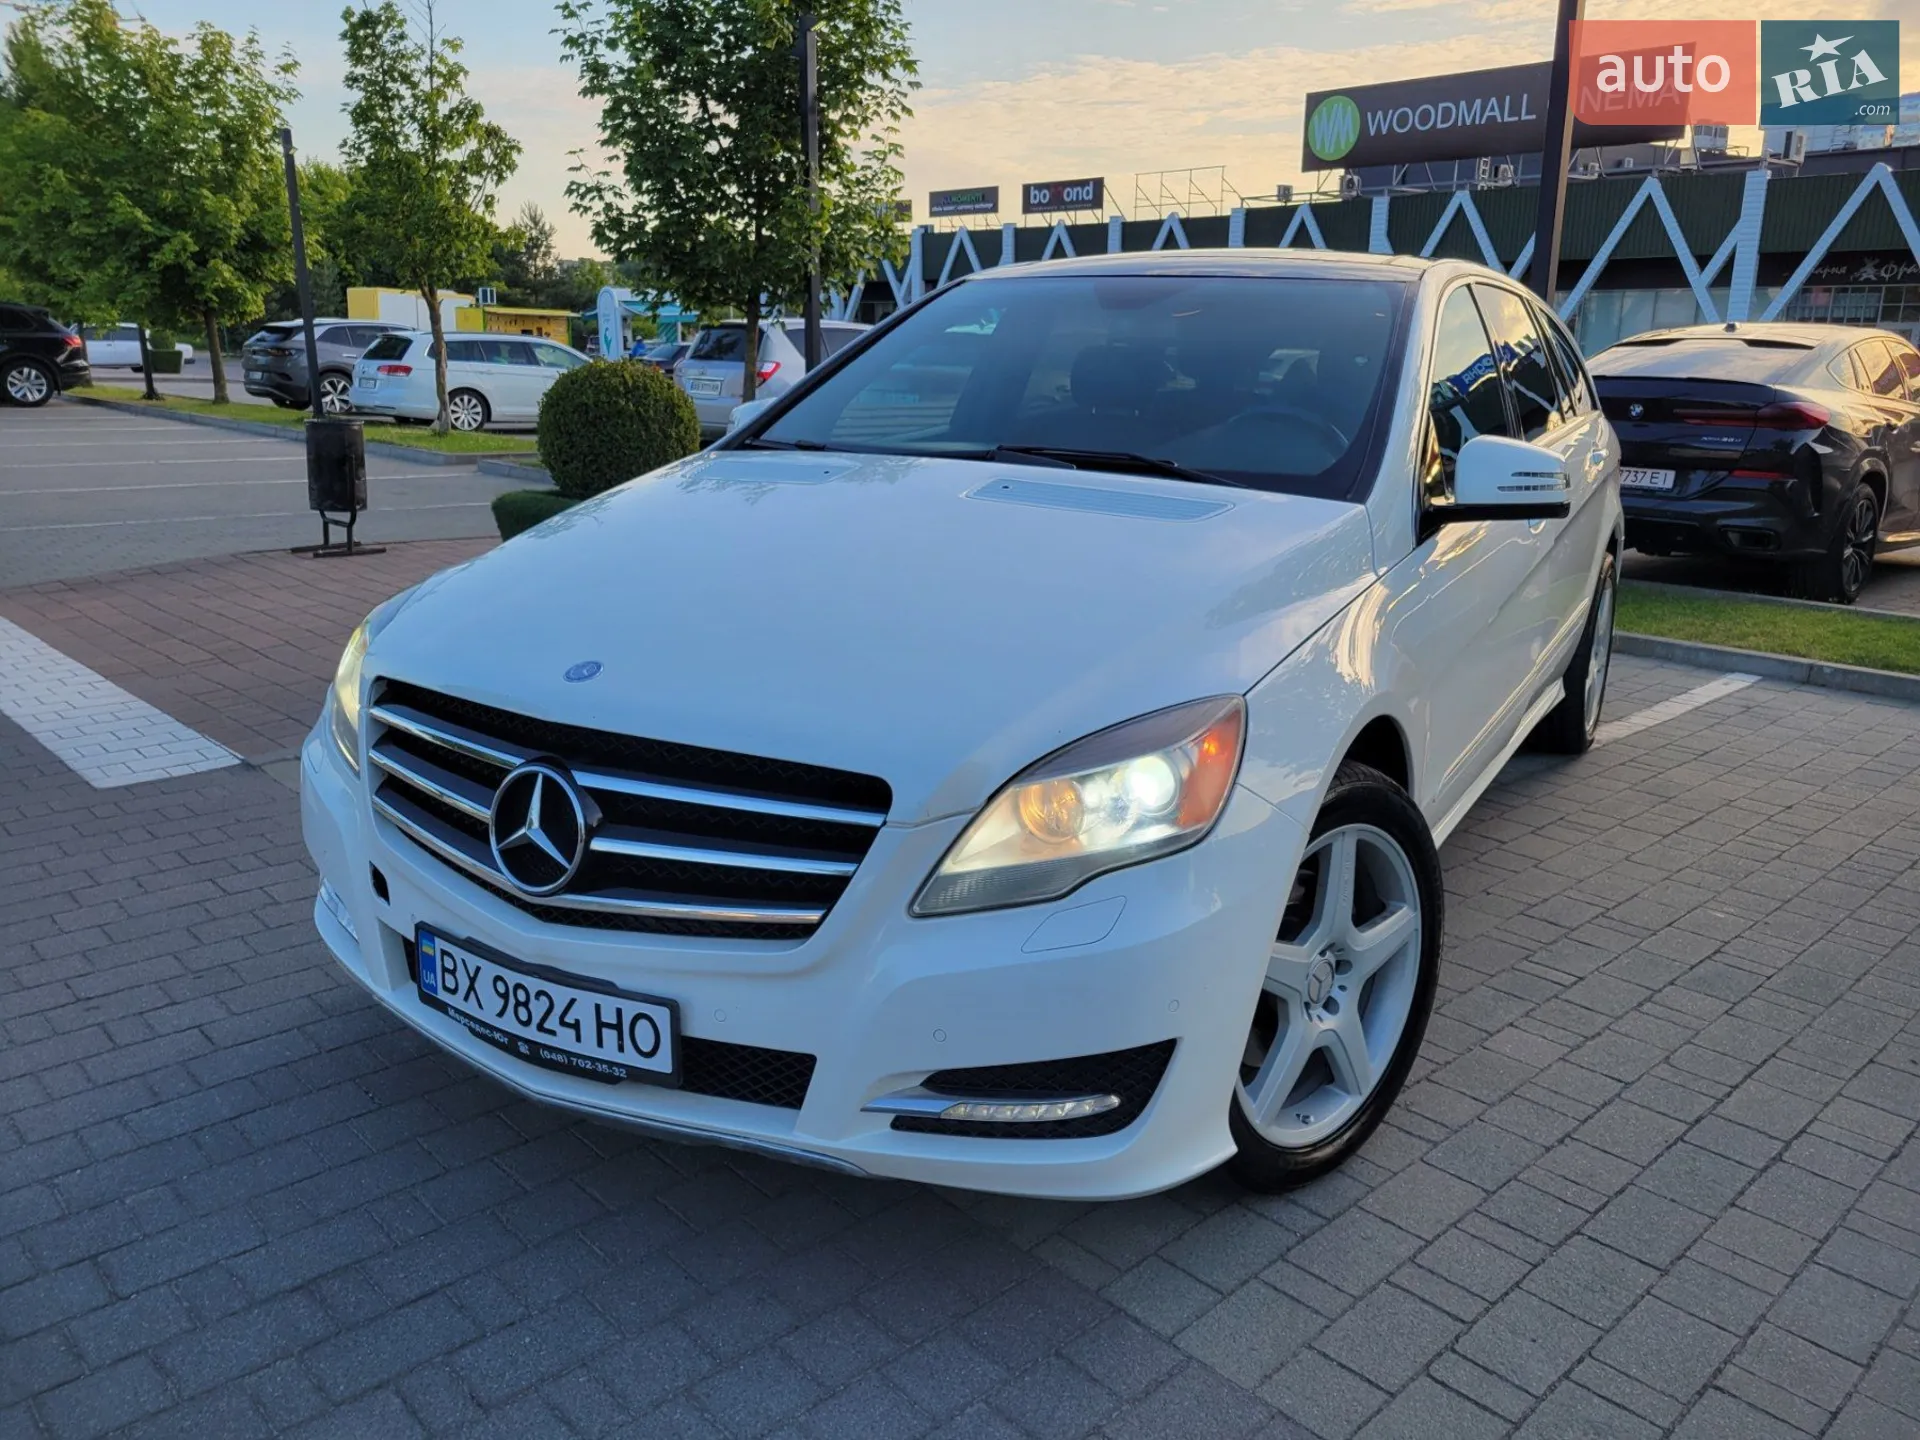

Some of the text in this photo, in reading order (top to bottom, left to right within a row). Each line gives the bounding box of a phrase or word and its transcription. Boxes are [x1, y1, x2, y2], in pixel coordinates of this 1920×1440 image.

[1367, 93, 1537, 136] WOODMALL
[422, 970, 437, 988] UA
[440, 948, 661, 1059] BX 9824 HO
[539, 1047, 568, 1065] (048)
[570, 1056, 628, 1079] 702-35-32
